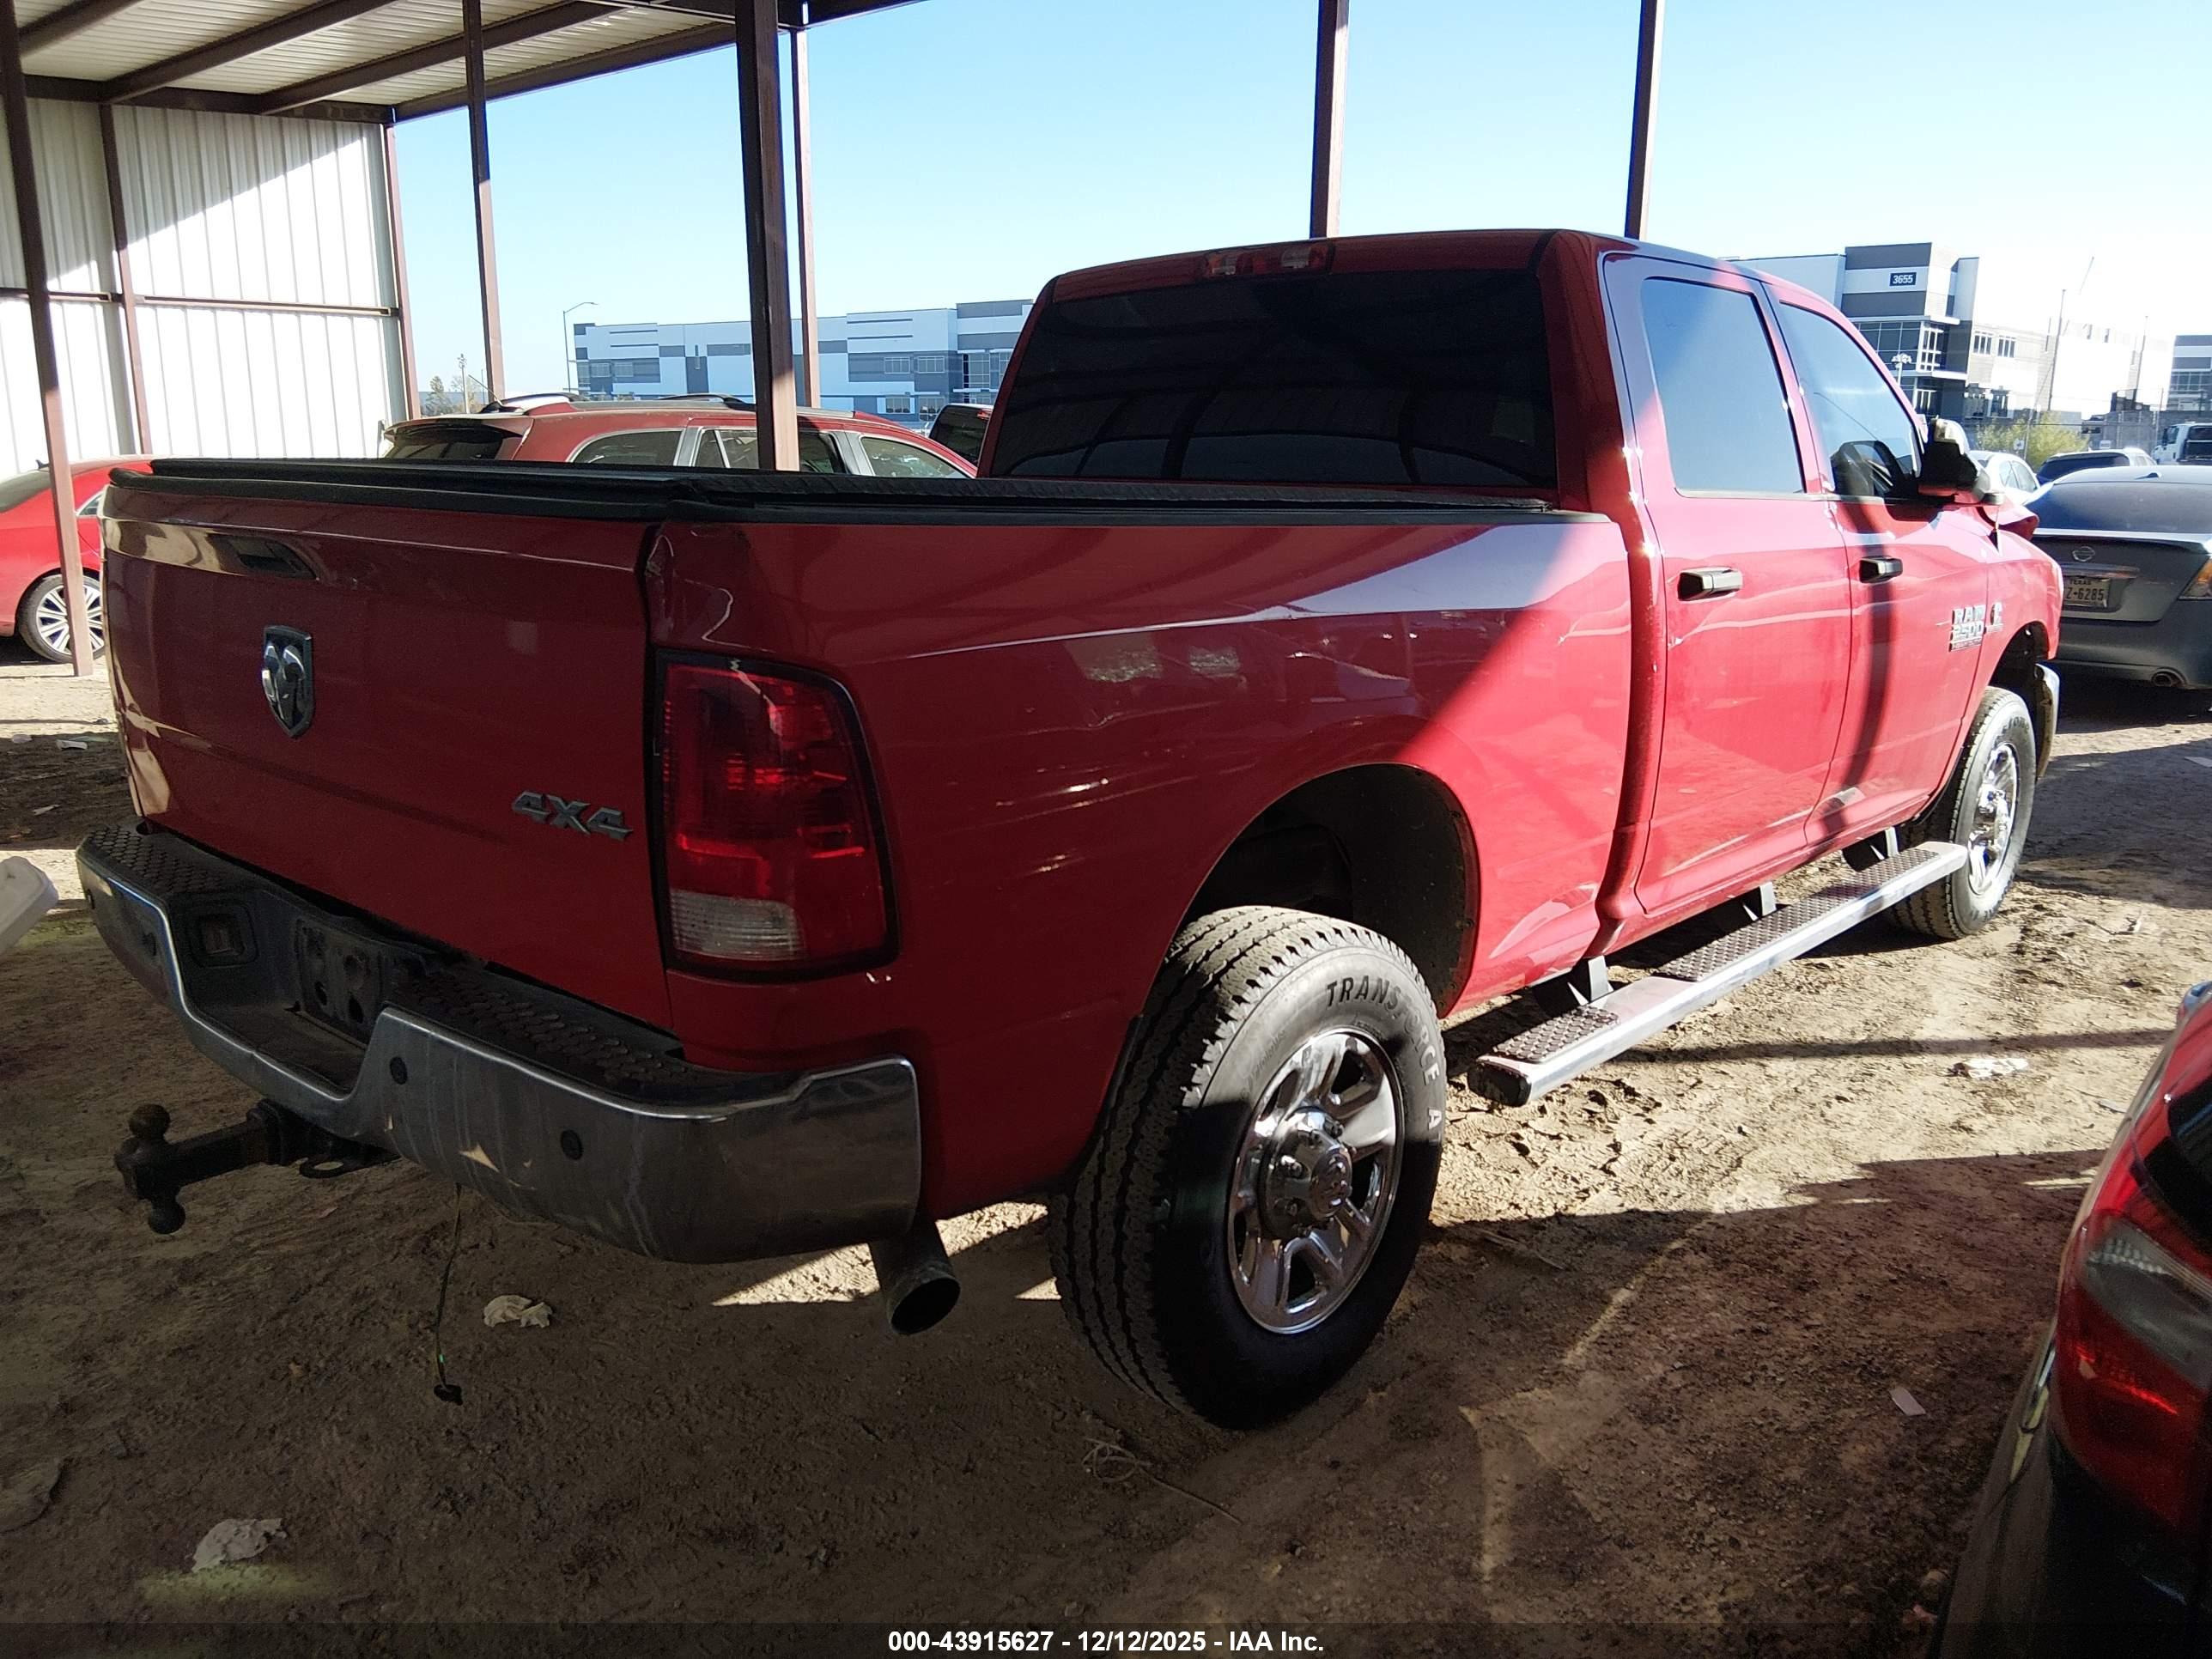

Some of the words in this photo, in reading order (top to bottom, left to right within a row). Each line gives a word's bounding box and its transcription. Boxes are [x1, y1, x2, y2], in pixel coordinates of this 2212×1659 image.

[1892, 275, 1914, 284] 3655
[2063, 586, 2105, 601] Z-6285
[1952, 605, 1986, 625] RAM
[1950, 621, 1984, 642] 2500
